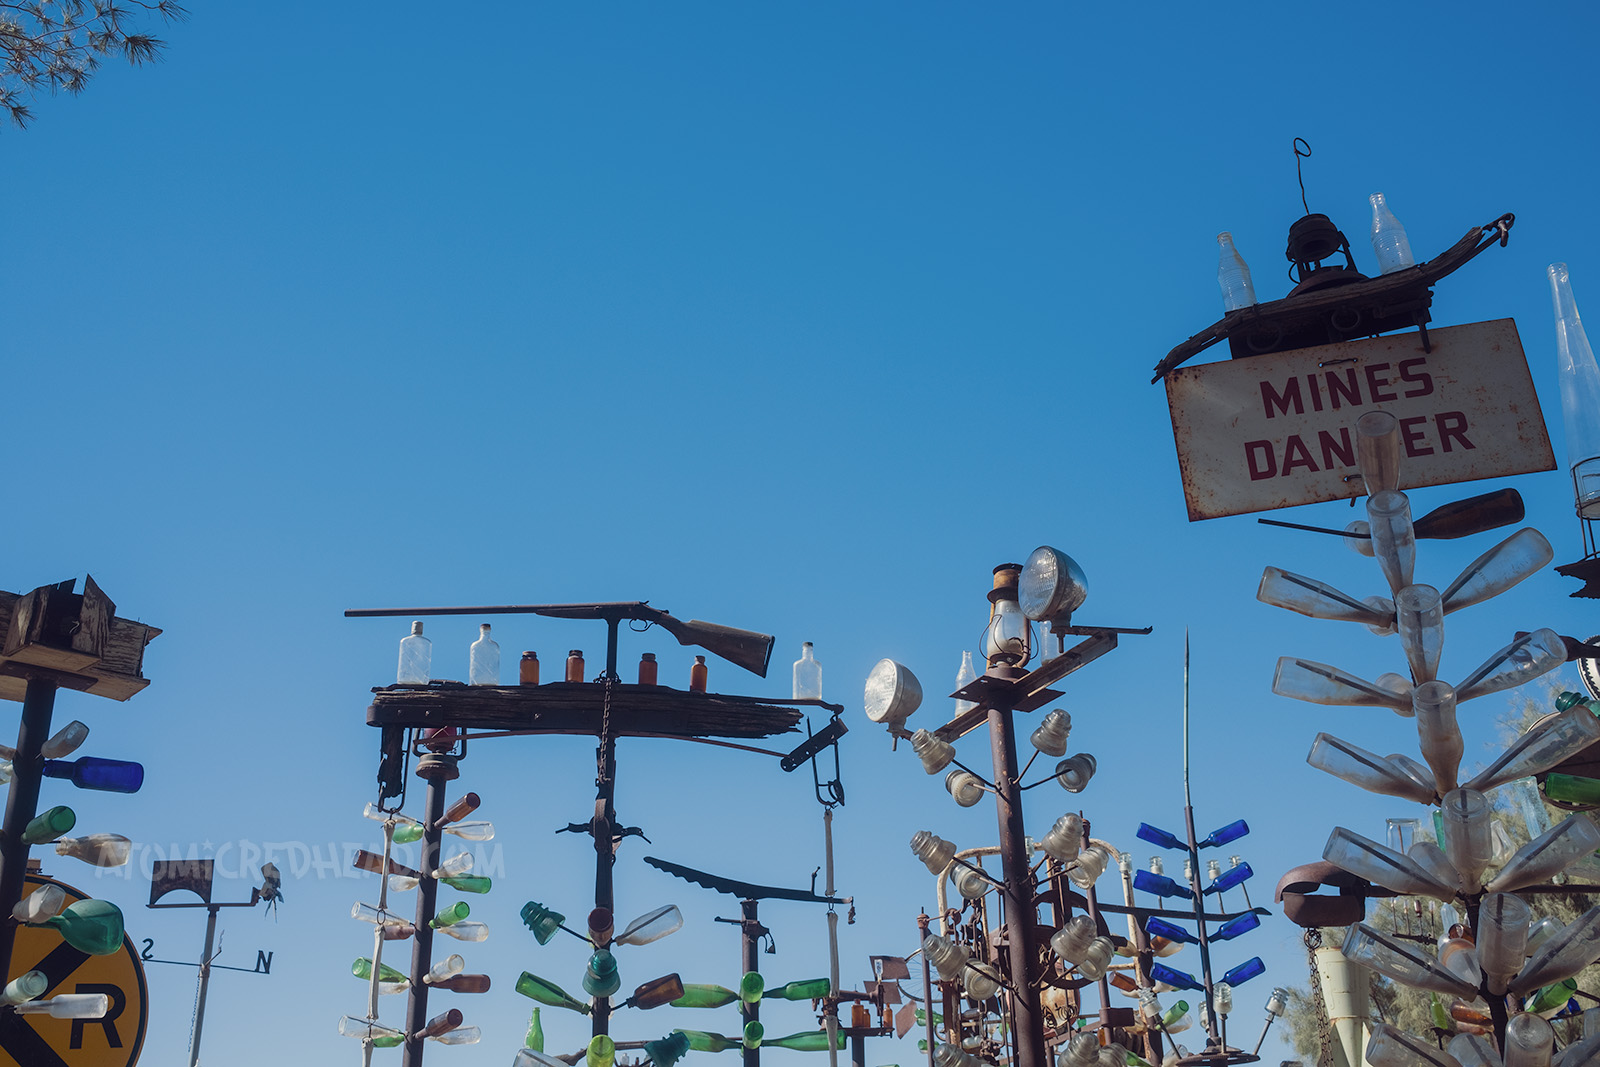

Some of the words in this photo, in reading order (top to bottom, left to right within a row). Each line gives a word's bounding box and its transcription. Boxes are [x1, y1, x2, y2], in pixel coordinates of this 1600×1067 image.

[1260, 358, 1433, 418] MINES
[1245, 412, 1476, 481] DANER
[255, 950, 273, 974] N
[69, 983, 126, 1049] R
